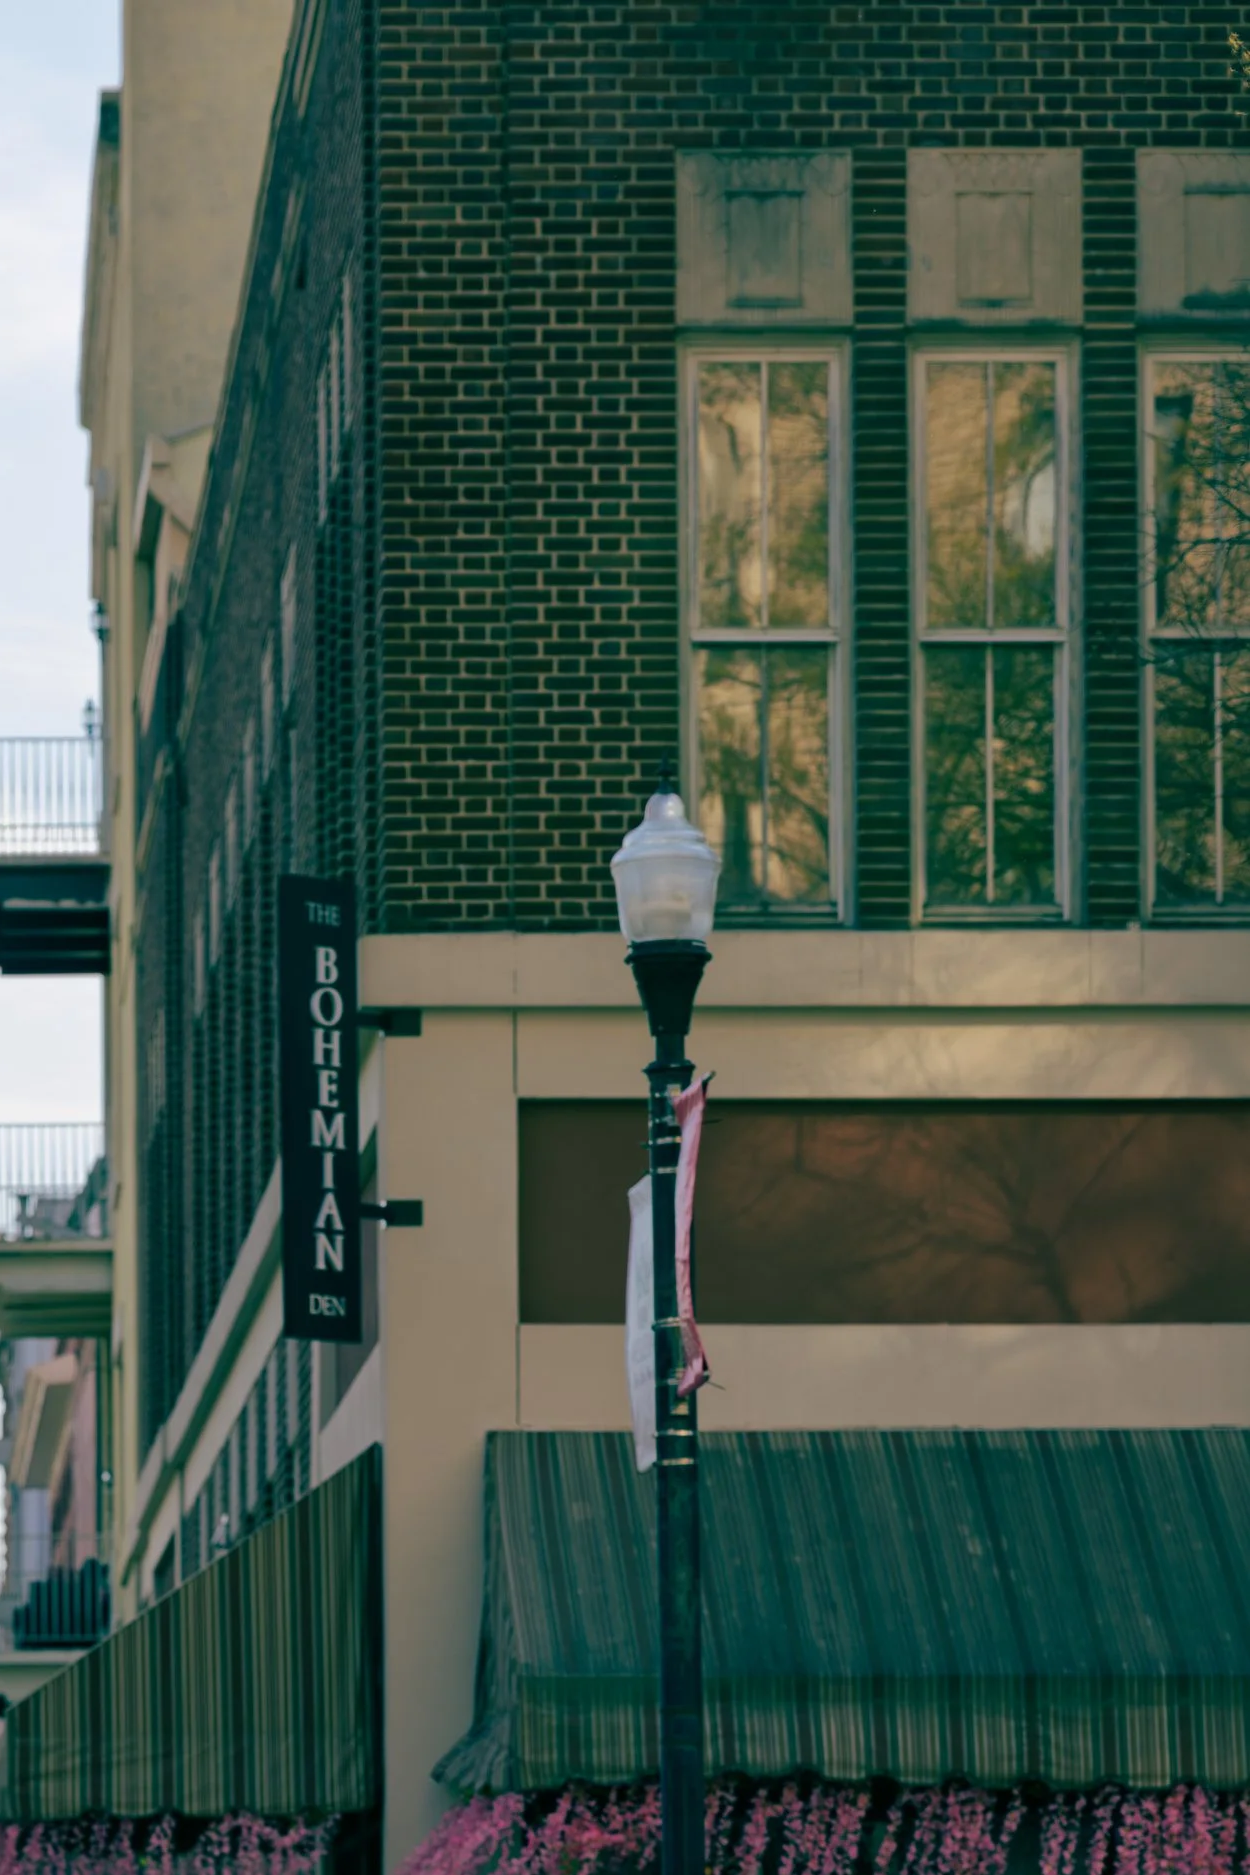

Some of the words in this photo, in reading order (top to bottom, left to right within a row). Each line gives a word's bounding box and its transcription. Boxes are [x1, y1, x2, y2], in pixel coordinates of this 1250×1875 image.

[306, 902, 340, 925] THE
[310, 946, 346, 1271] BOHEMIAN
[309, 1294, 345, 1317] DEN
